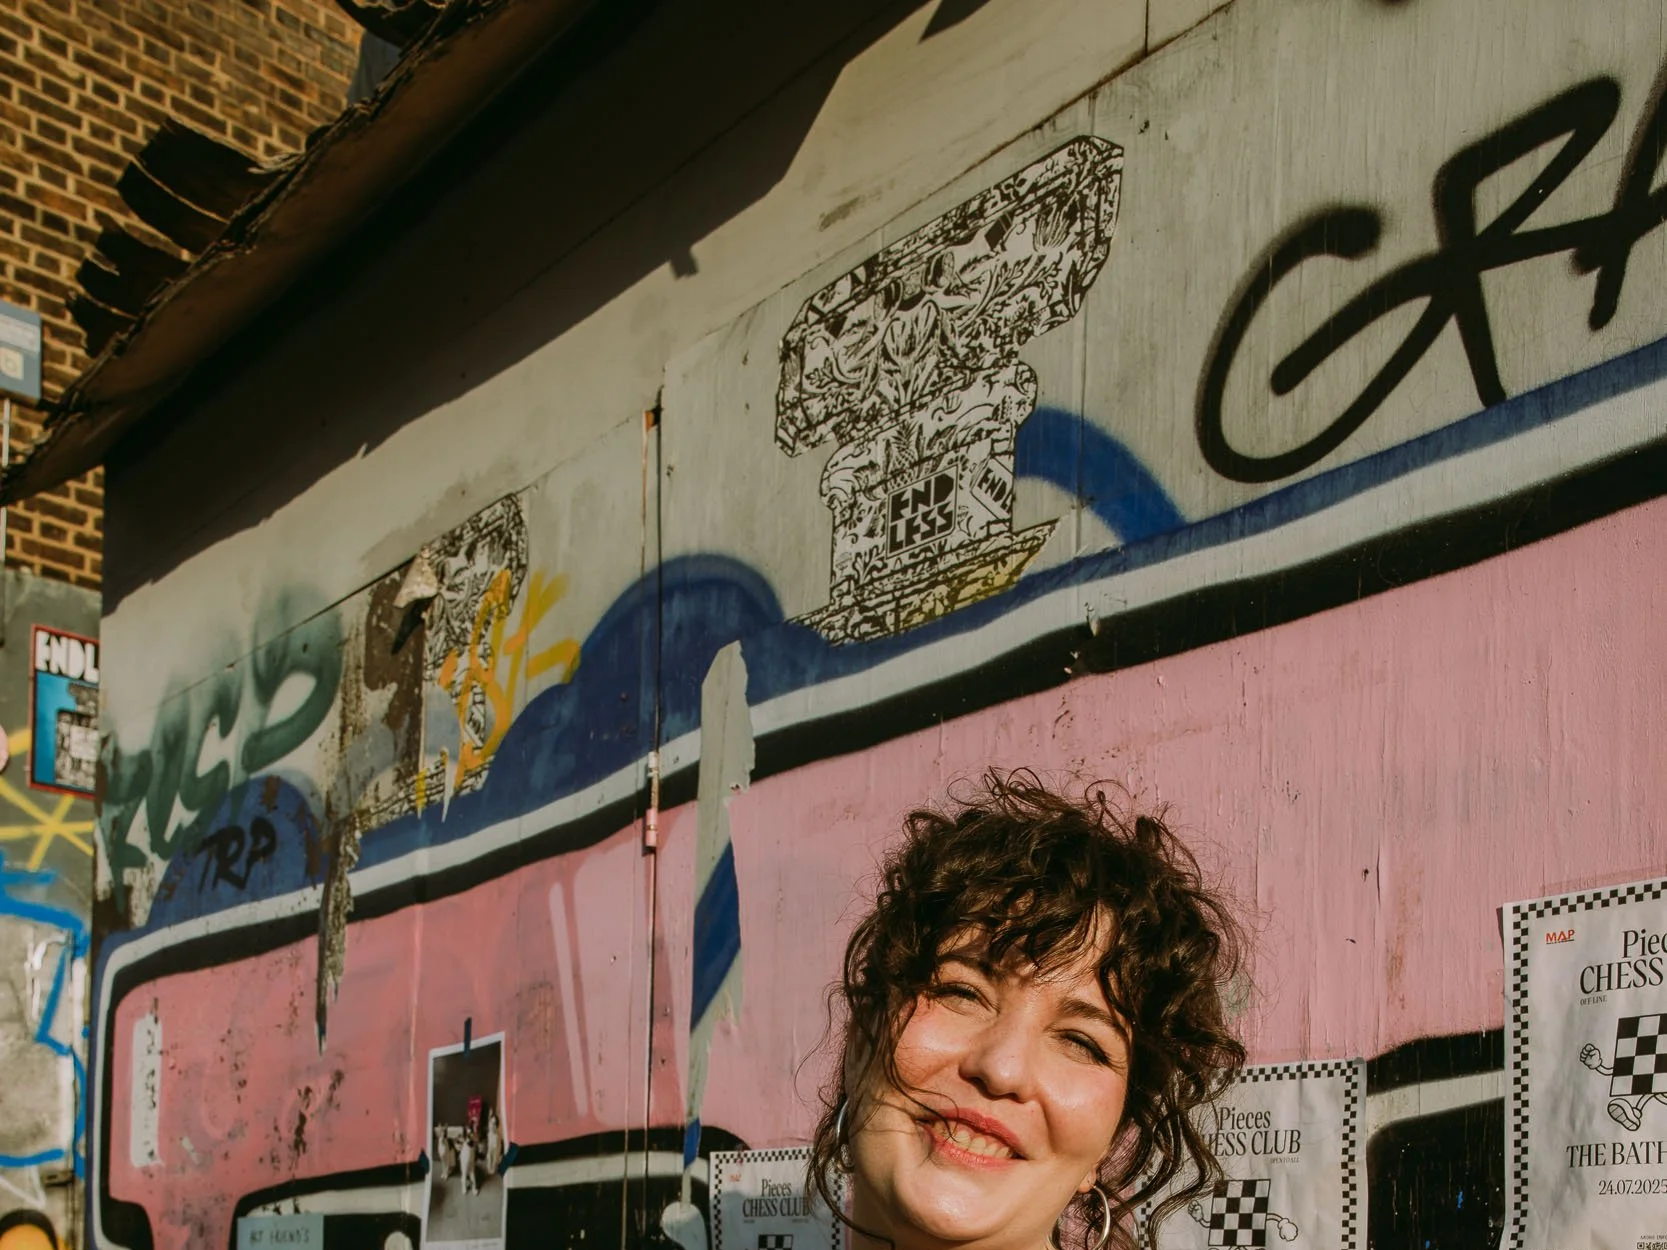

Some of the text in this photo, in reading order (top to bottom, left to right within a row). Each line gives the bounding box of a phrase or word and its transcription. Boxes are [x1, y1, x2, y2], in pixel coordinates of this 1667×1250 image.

[891, 473, 954, 523] END
[890, 501, 953, 553] LESS
[1546, 929, 1575, 943] MAP
[1580, 956, 1664, 995] CHESS
[1219, 1106, 1272, 1131] Pieces
[1251, 1129, 1302, 1156] CLUB
[1566, 1140, 1667, 1168] THE BATH
[761, 1178, 792, 1197] Pieces
[1598, 1178, 1667, 1196] 24.07.2025
[742, 1197, 778, 1217] CHESS
